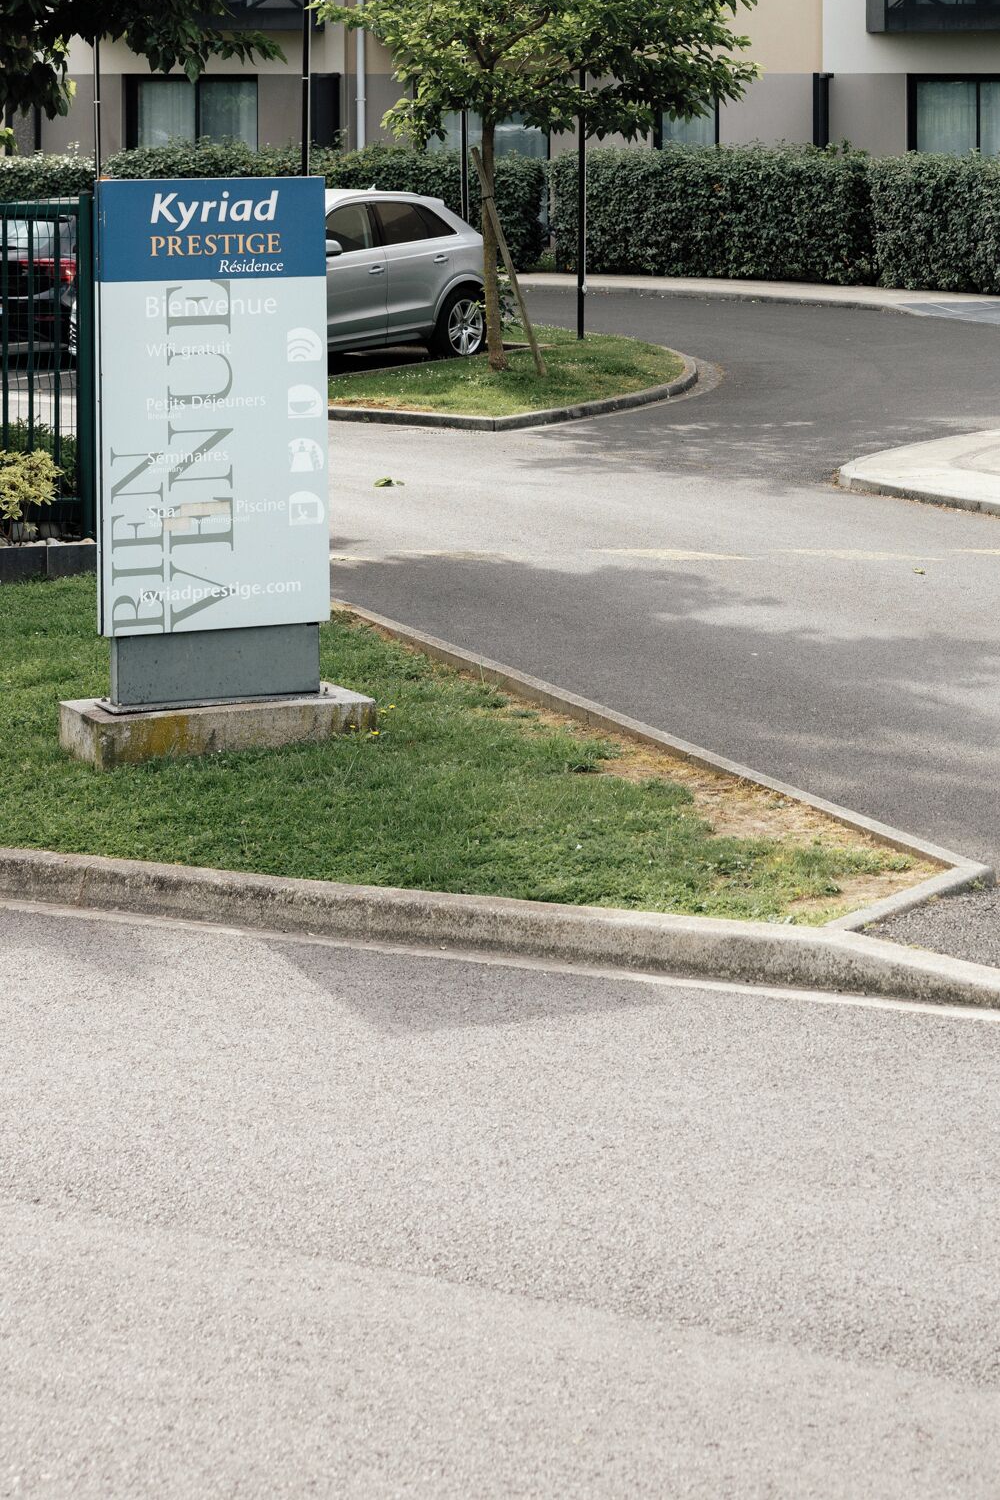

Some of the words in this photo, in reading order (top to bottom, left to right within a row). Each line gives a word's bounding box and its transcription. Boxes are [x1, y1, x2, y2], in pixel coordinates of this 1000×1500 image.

[150, 190, 280, 232] Kyriad
[150, 233, 282, 257] PRESTIGE
[218, 259, 284, 273] Résidence
[145, 296, 278, 318] Bienvenue
[146, 342, 176, 357] Wifi
[182, 341, 232, 360] gratuit
[146, 396, 186, 411] Petits
[191, 393, 267, 413] Déjeuners
[147, 448, 229, 465] Séminaires
[148, 504, 176, 521] Spa
[235, 498, 286, 513] Piscine
[139, 578, 302, 606] kyriadprestige.com
